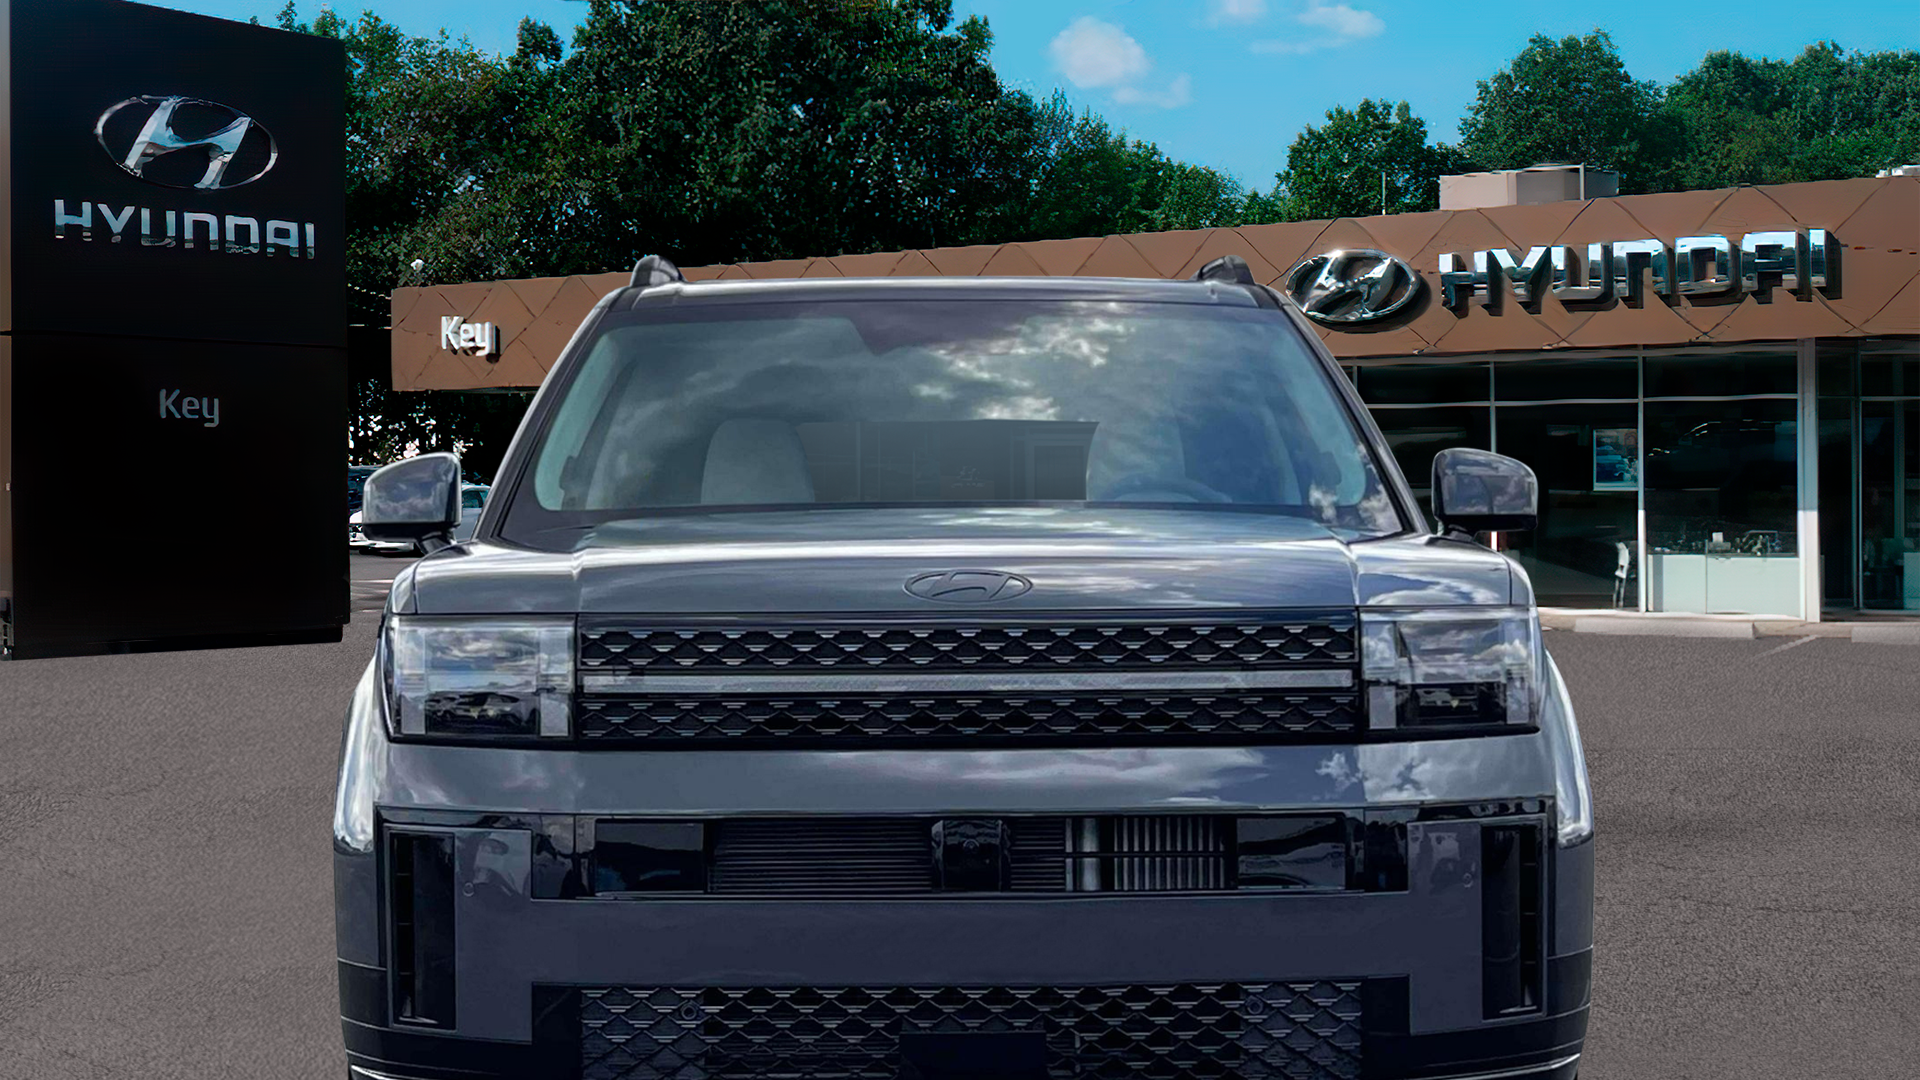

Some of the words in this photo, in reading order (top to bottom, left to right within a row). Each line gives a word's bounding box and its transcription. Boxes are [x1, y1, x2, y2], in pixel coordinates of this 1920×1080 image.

[54, 199, 315, 260] HYUNDAI
[1438, 228, 1838, 316] HYUNDAI
[441, 315, 495, 357] Key
[159, 388, 220, 427] Key
